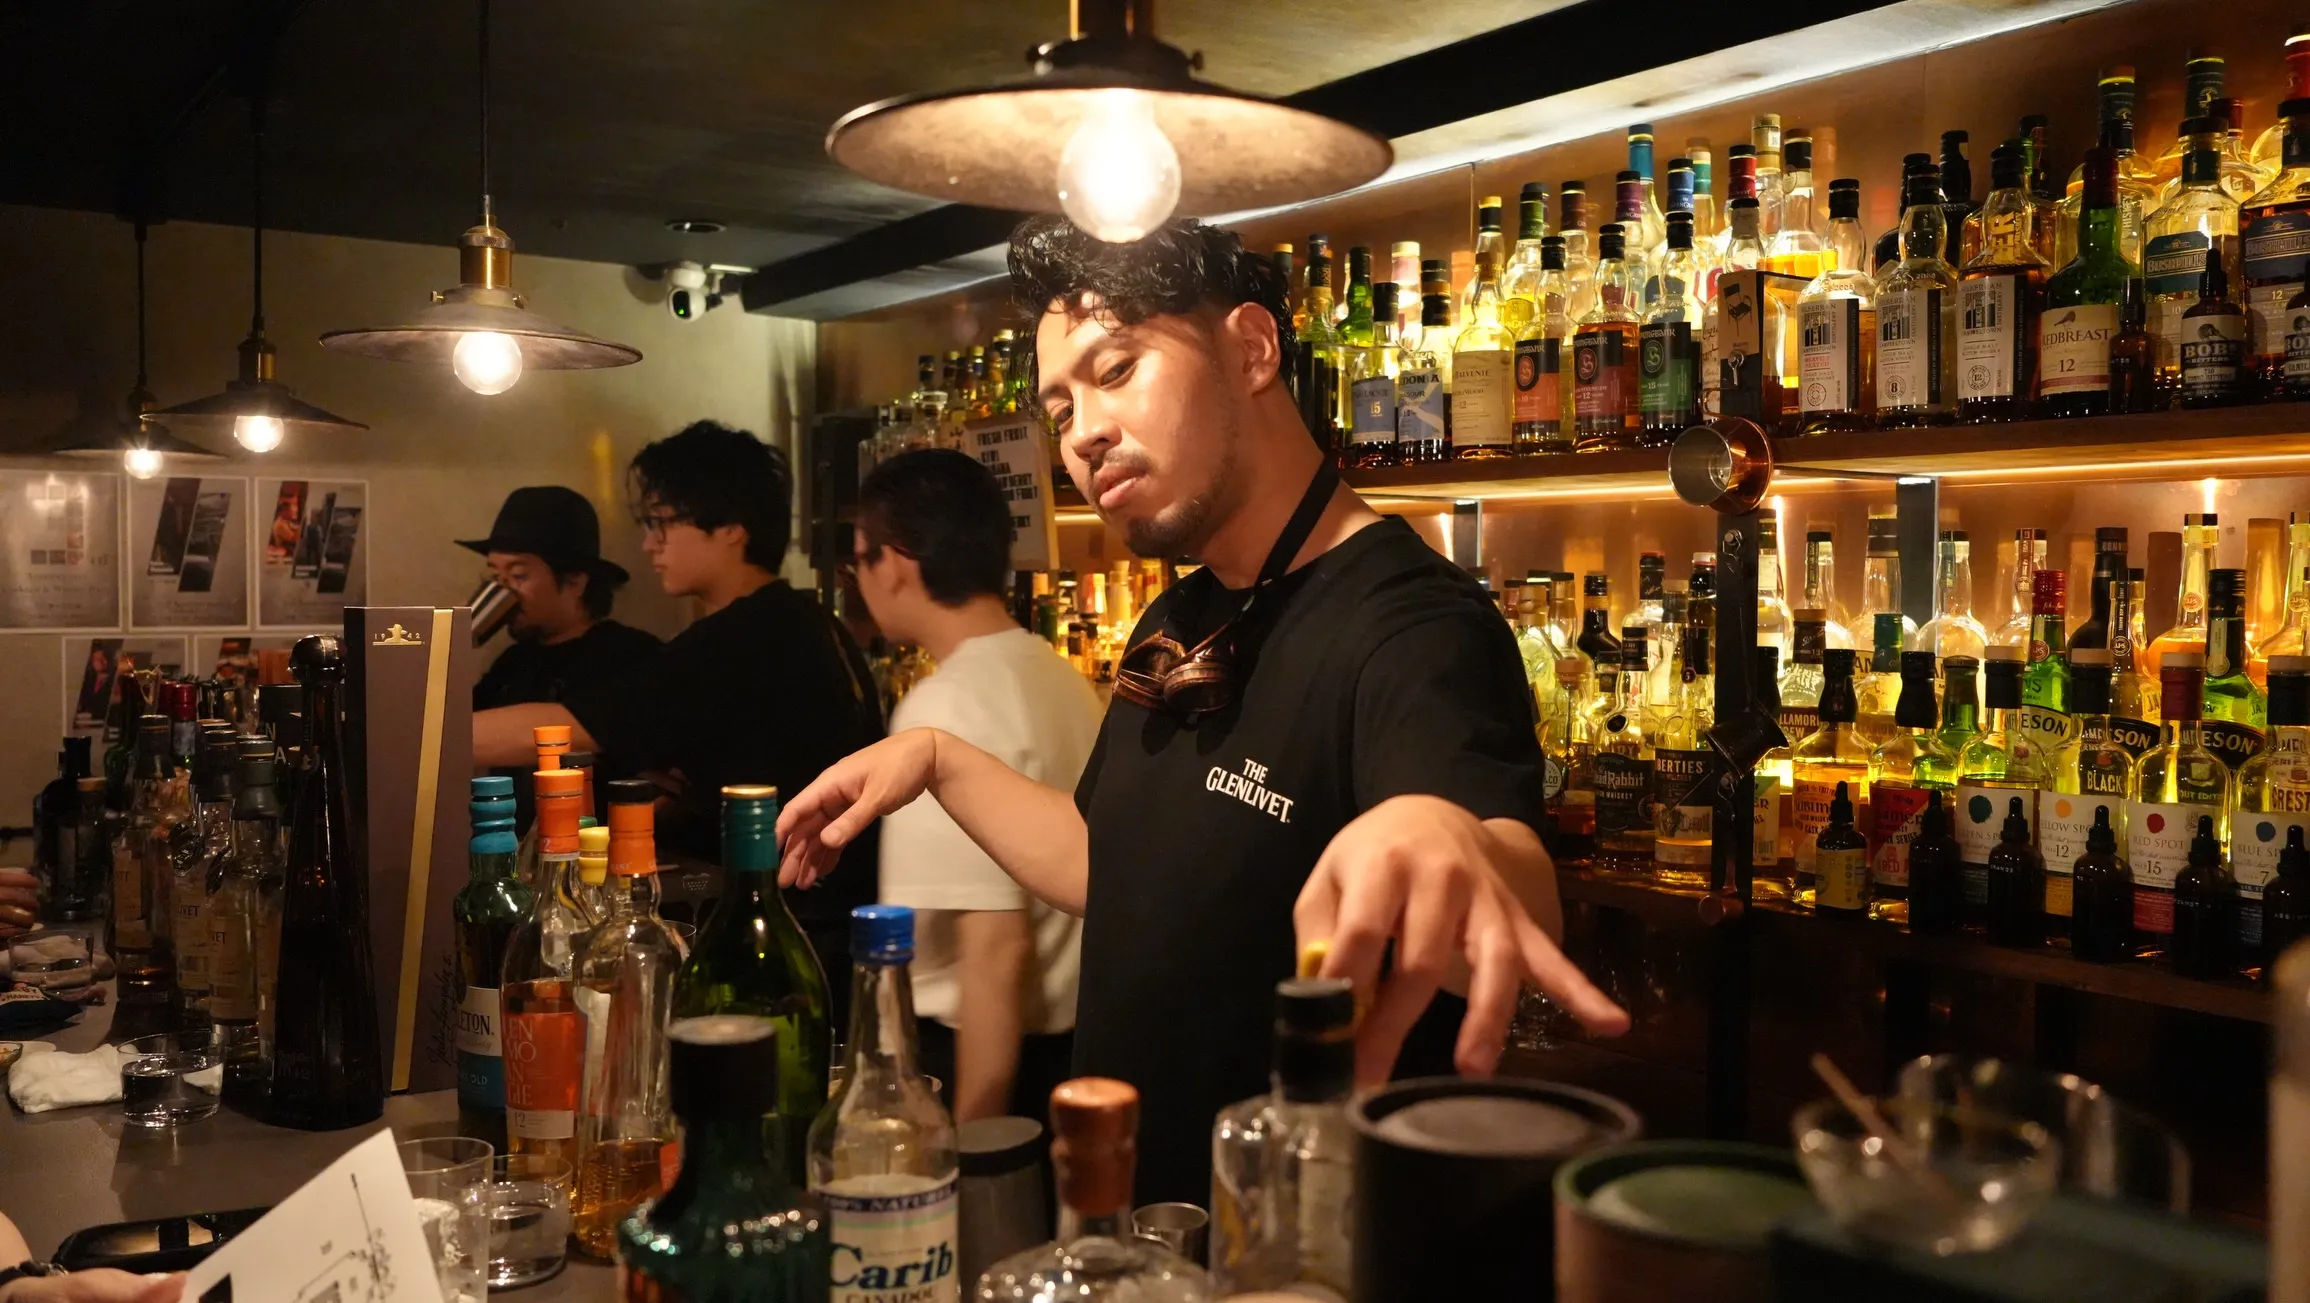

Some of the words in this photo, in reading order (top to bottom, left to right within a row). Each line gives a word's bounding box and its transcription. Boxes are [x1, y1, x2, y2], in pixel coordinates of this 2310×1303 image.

[2147, 253, 2207, 273] BUSHMILLS
[2272, 290, 2283, 300] 12
[2042, 328, 2113, 346] REDBREAST
[2059, 359, 2075, 373] 12
[1371, 401, 1382, 414] 15
[977, 431, 1002, 446] FRESH
[1004, 426, 1028, 442] FRUIT
[1779, 713, 1819, 727] LLAMOR
[1243, 758, 1269, 784] THE
[1656, 758, 1704, 774] BERTIES
[2087, 771, 2123, 794] BLACK
[1606, 791, 1633, 800] WHISKEY
[2272, 786, 2310, 812] CREST
[2073, 824, 2091, 834] SPO
[2133, 836, 2151, 846] RED
[2155, 839, 2185, 850] SPOT
[2237, 844, 2261, 856] BLUE
[2055, 844, 2069, 858] 12
[2147, 860, 2162, 875] 15
[2260, 871, 2269, 884] 7
[471, 1074, 488, 1085] OLD
[514, 1111, 526, 1128] 12
[829, 1241, 953, 1290] Carib
